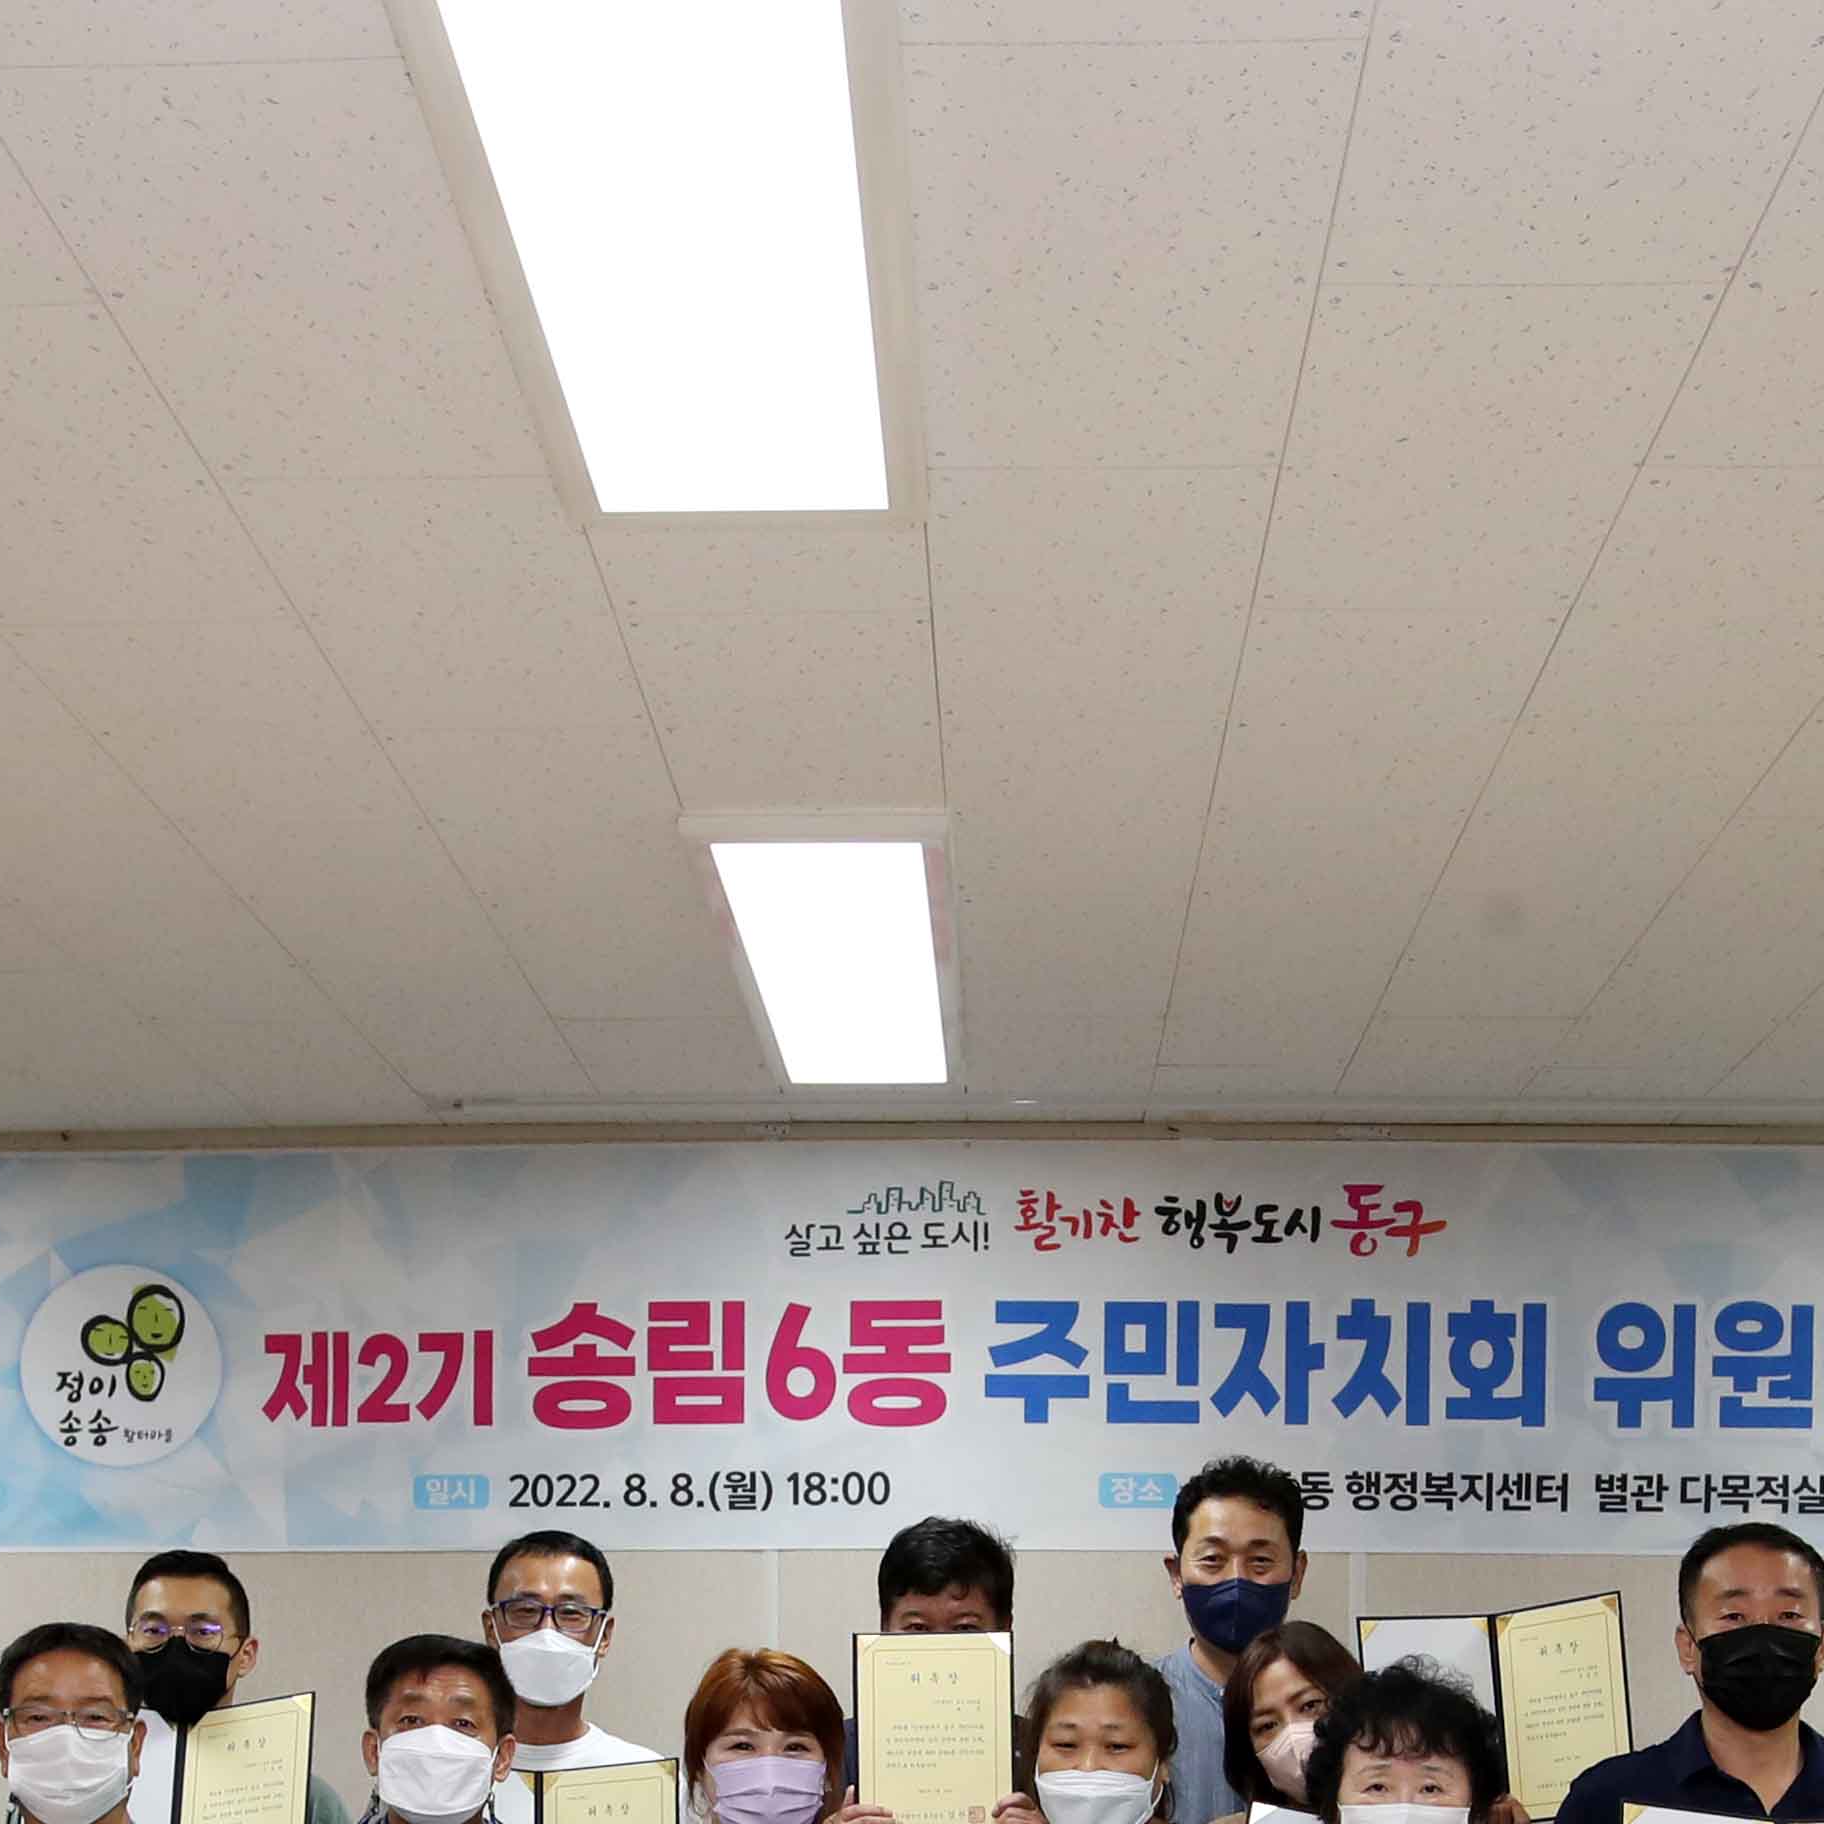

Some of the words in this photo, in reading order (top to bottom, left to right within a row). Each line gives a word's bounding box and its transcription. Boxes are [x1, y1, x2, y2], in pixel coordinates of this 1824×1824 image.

[784, 1223, 845, 1257] 살고
[852, 1221, 913, 1256] 싶은
[920, 1220, 990, 1253] 도시!
[1014, 1188, 1142, 1252] 활기찬
[1153, 1190, 1321, 1255] 행복도시
[1330, 1183, 1448, 1258] 동구
[261, 1329, 494, 1428] 제2기
[527, 1299, 952, 1430] 송림6동
[984, 1299, 1546, 1428] 주민자치회
[1594, 1302, 1814, 1430] 위원
[55, 1370, 117, 1403] 정이
[59, 1408, 119, 1447] 송송
[426, 1479, 476, 1506] 일시
[508, 1473, 612, 1509] 2022.
[623, 1473, 659, 1508] 8.
[786, 1471, 891, 1507] 18:00
[1110, 1475, 1165, 1504] 장소
[1344, 1470, 1570, 1513] 행정복지센터
[1594, 1472, 1670, 1513] 별관
